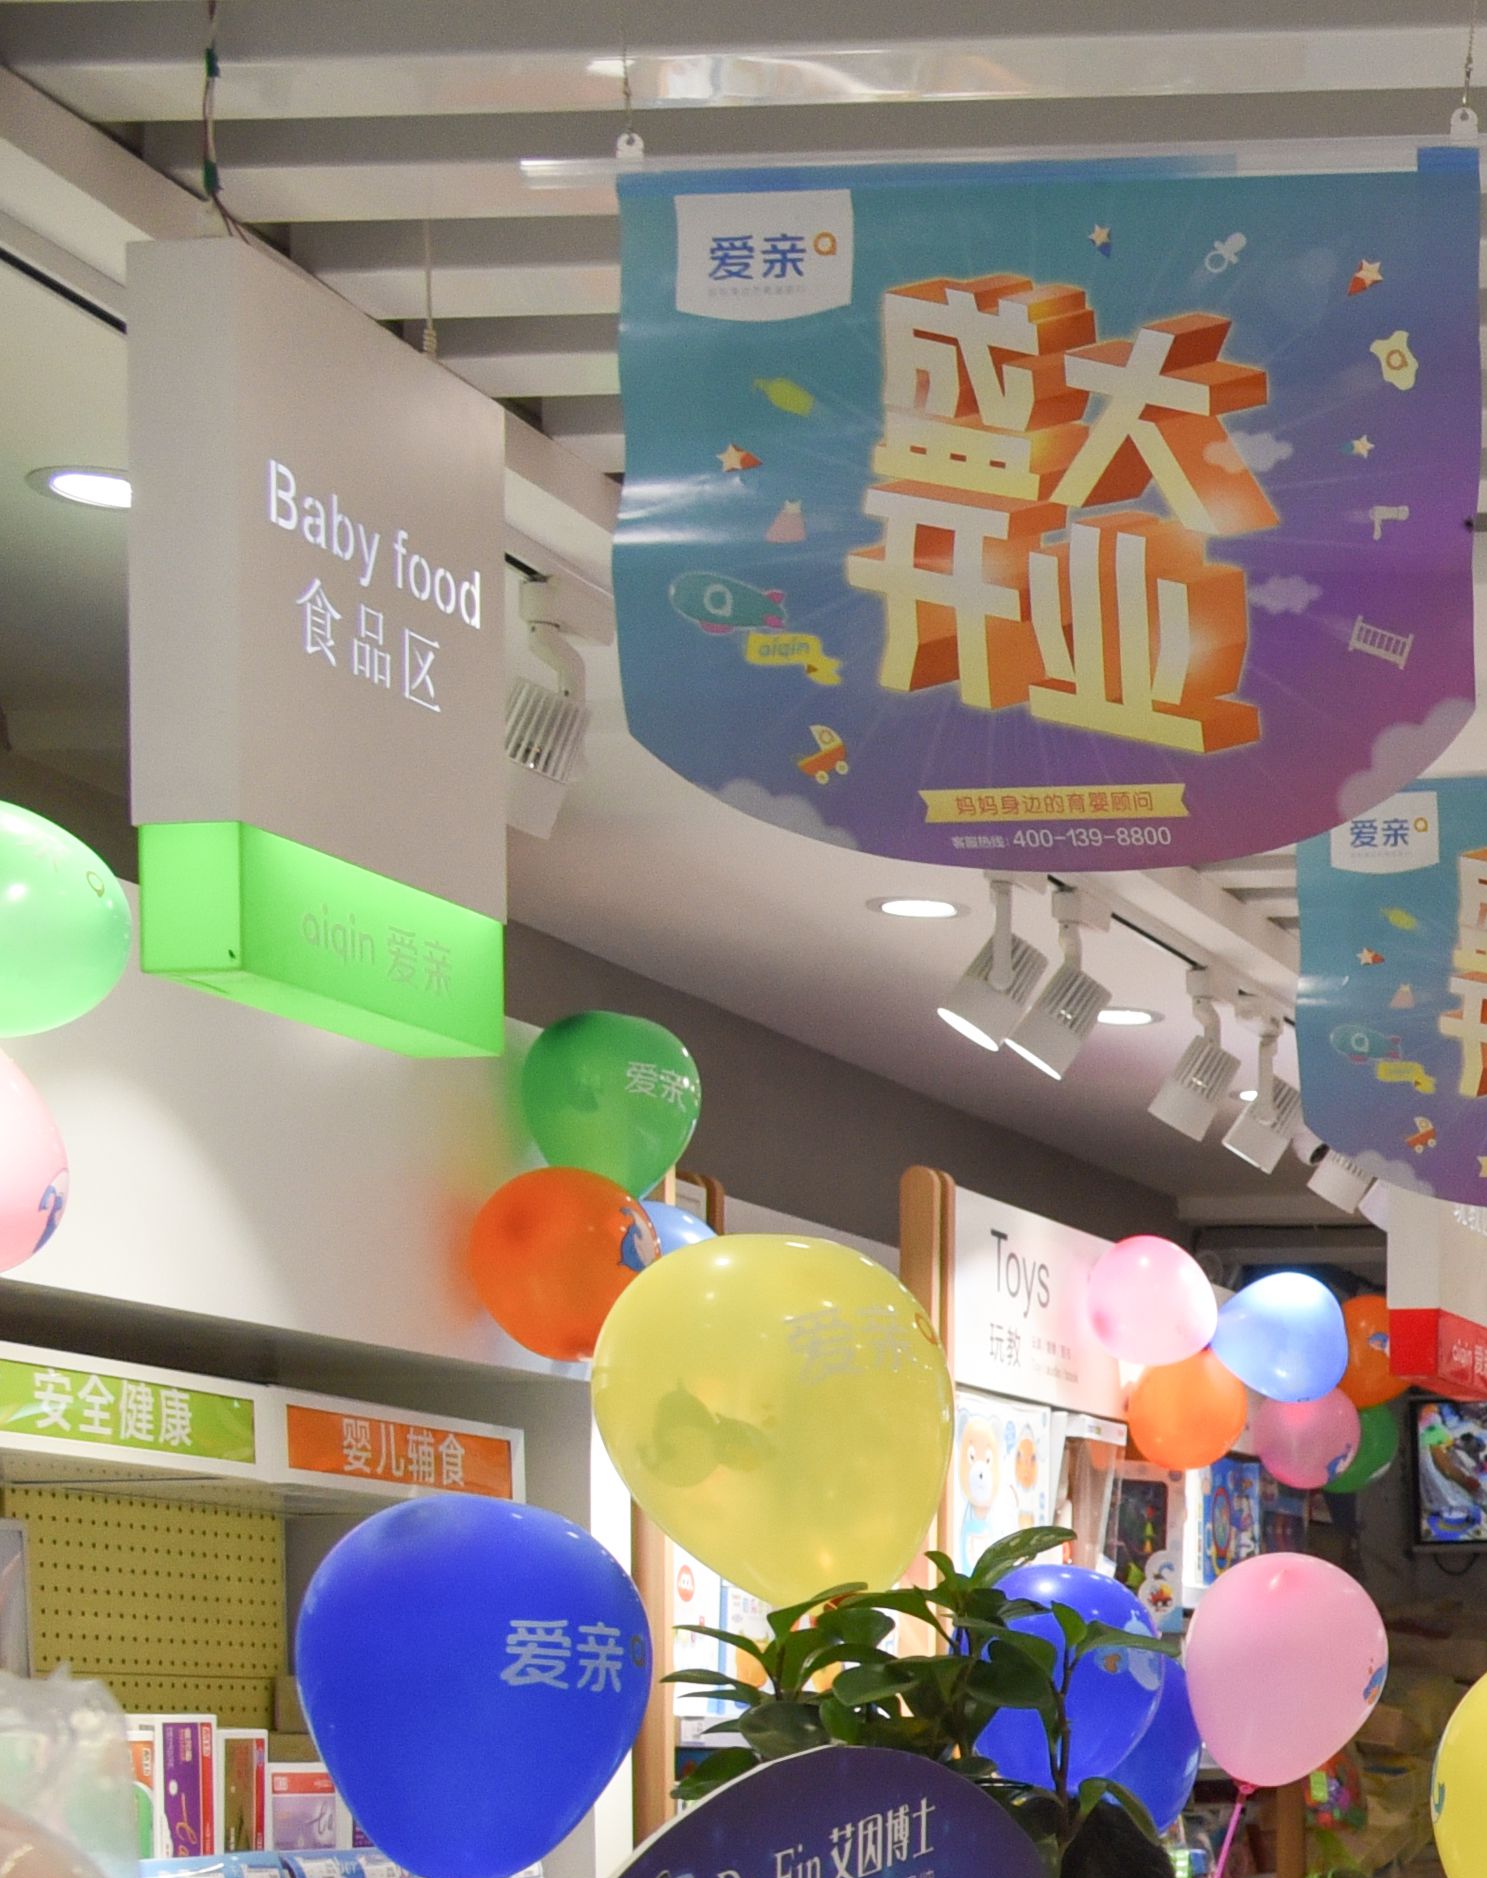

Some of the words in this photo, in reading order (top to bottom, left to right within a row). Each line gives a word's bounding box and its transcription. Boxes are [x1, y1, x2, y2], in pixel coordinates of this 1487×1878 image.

[709, 234, 806, 281] 爱亲
[870, 276, 1280, 535] 盛大
[268, 458, 380, 589] Baby
[393, 529, 482, 631] food
[296, 578, 442, 713] 食品区
[846, 482, 1261, 753] 开业
[955, 791, 1154, 816] 妈妈身边的育婴顾问
[1011, 825, 1172, 849] 400-139-8800
[1350, 818, 1410, 848] 爱亲
[300, 902, 377, 970] aiqin
[387, 926, 454, 994] 爱亲
[624, 1060, 690, 1112] 爱亲
[990, 1229, 1051, 1319] Toys
[987, 1324, 1022, 1369] 玩教
[32, 1367, 193, 1449] 安全健康
[341, 1416, 466, 1487] 婴儿辅食
[499, 1618, 625, 1692] 爱亲
